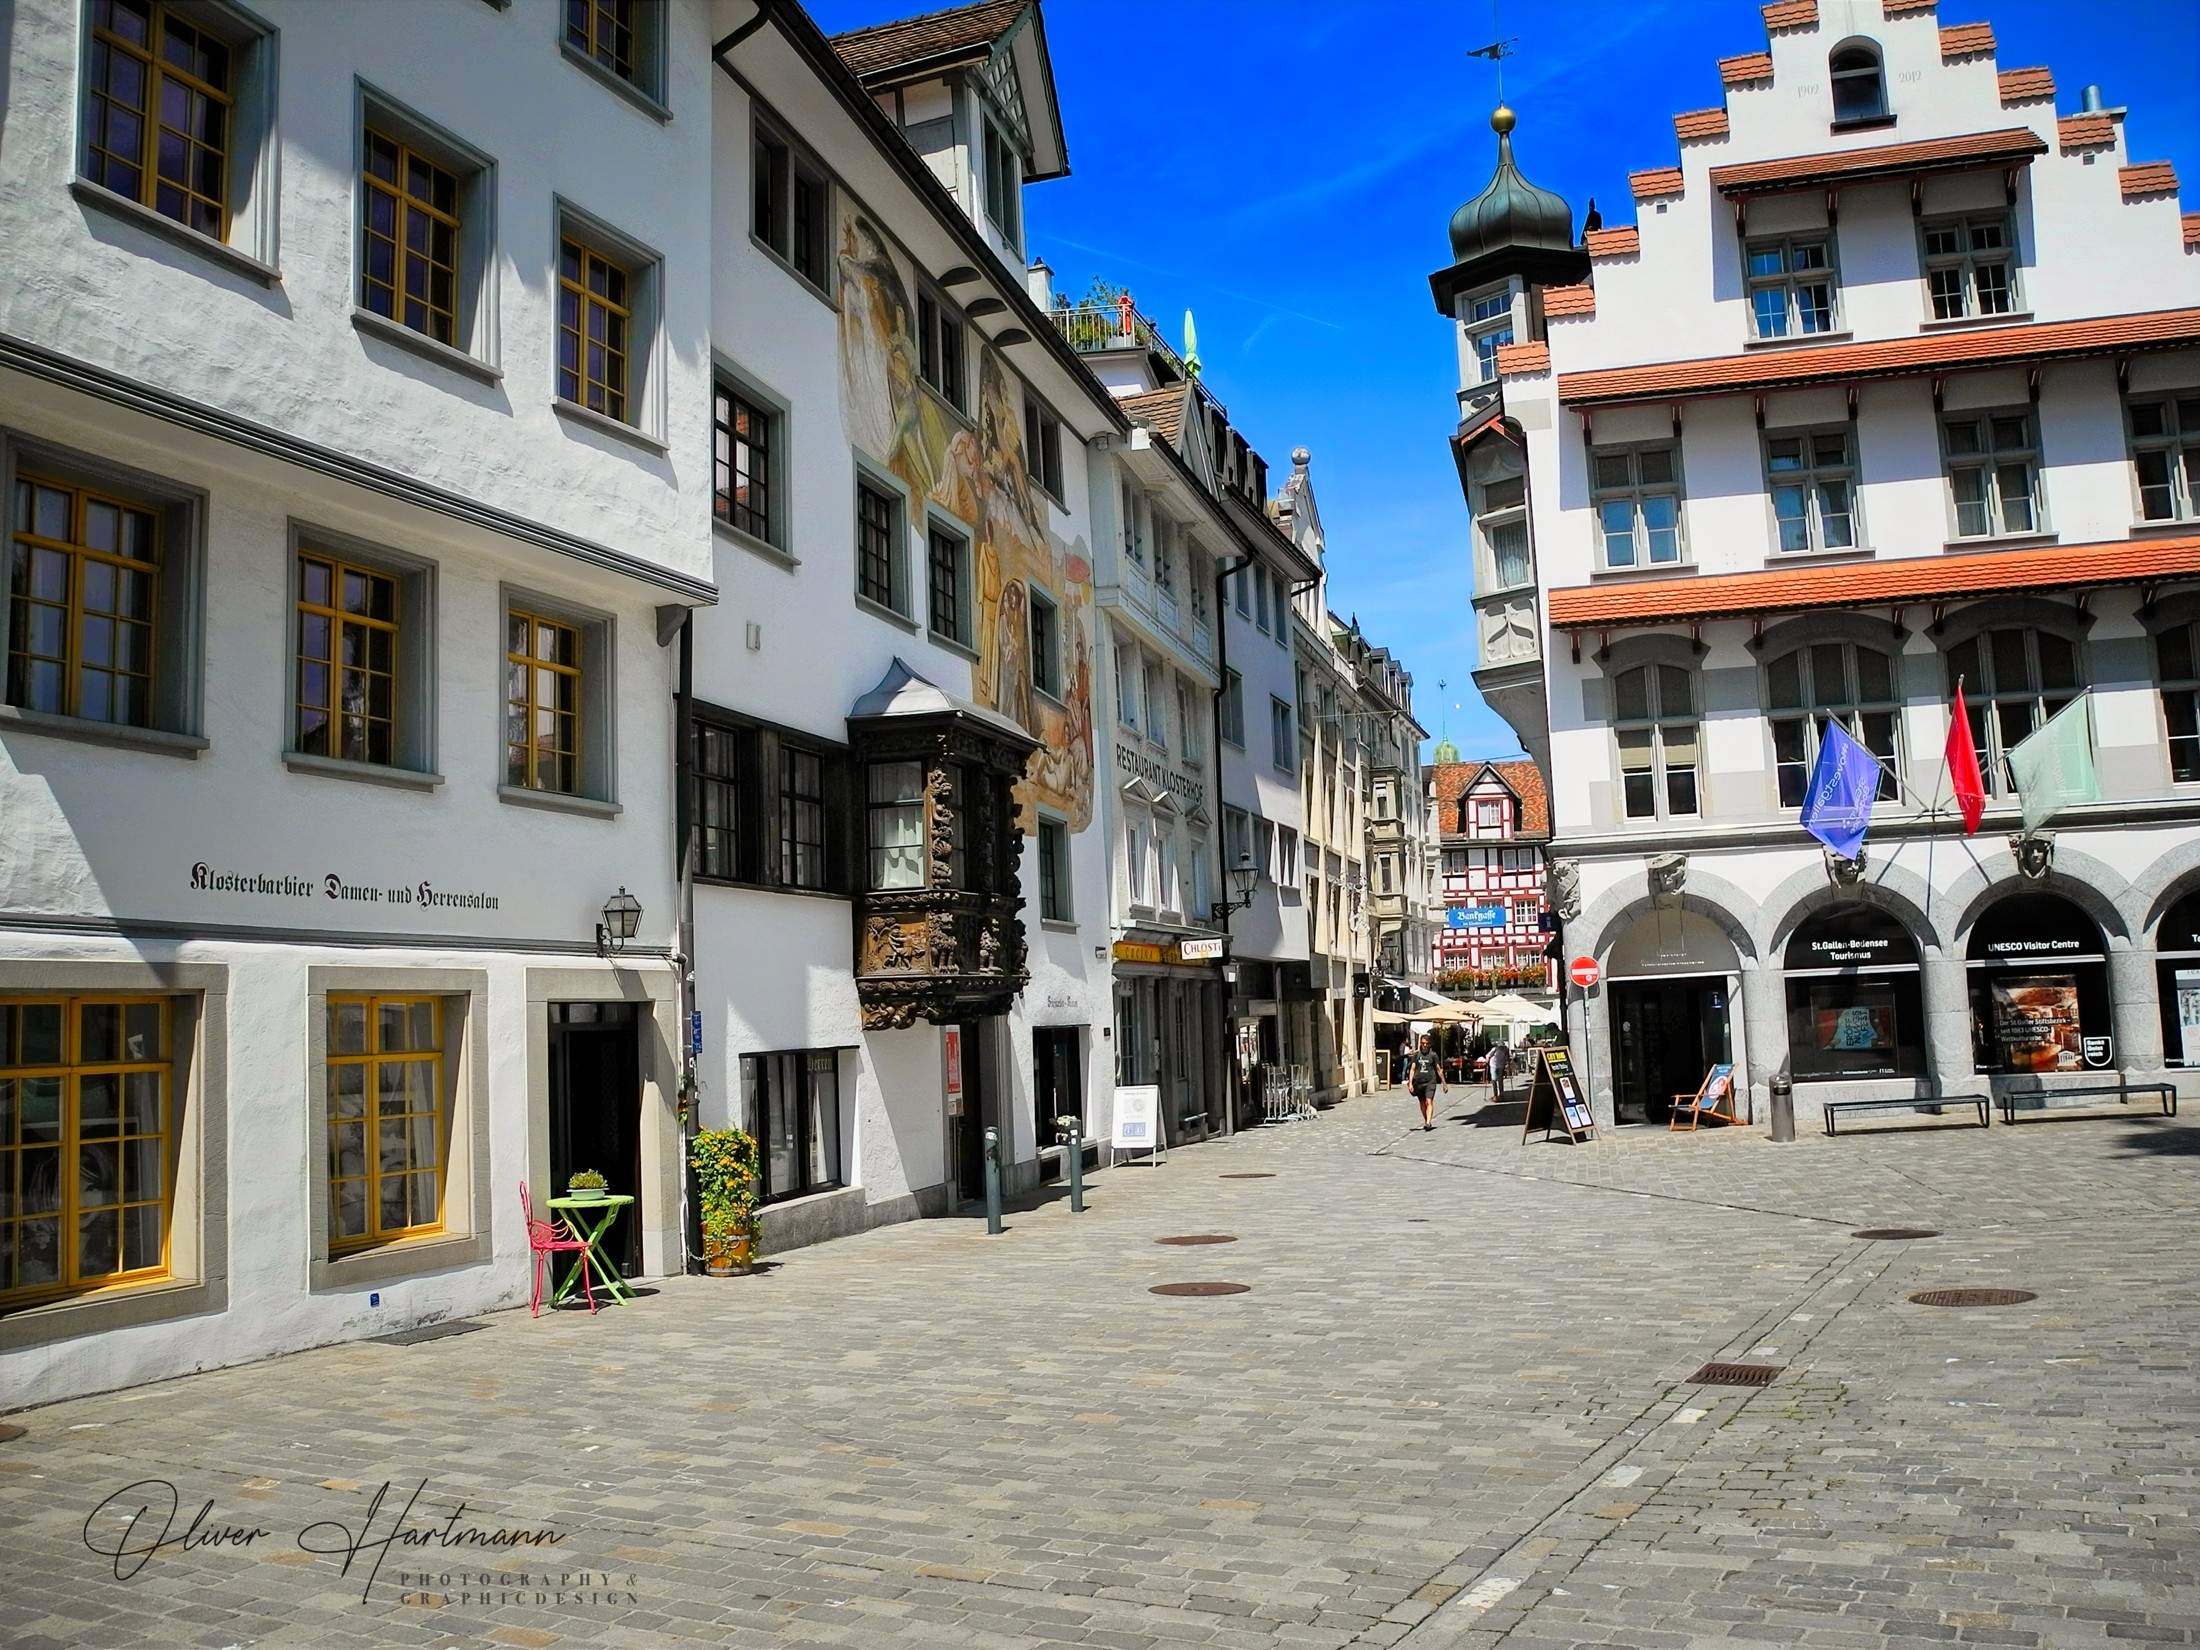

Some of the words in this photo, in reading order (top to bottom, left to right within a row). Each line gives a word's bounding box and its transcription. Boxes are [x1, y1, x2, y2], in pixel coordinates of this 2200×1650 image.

[1116, 743, 1161, 786] RESTAURANT
[1162, 768, 1203, 803] KLOSTERHOF
[190, 861, 313, 897] Klosterbarbier
[324, 873, 383, 899] Damen-
[388, 886, 412, 904] und
[416, 880, 500, 912] Herrensalon
[1811, 938, 1889, 951] St.Gallen-Bodensee
[1988, 942, 2022, 952] UNESCO
[2023, 940, 2050, 951] Visitor
[2051, 940, 2080, 949] Centre
[1830, 951, 1871, 961] Tourismus
